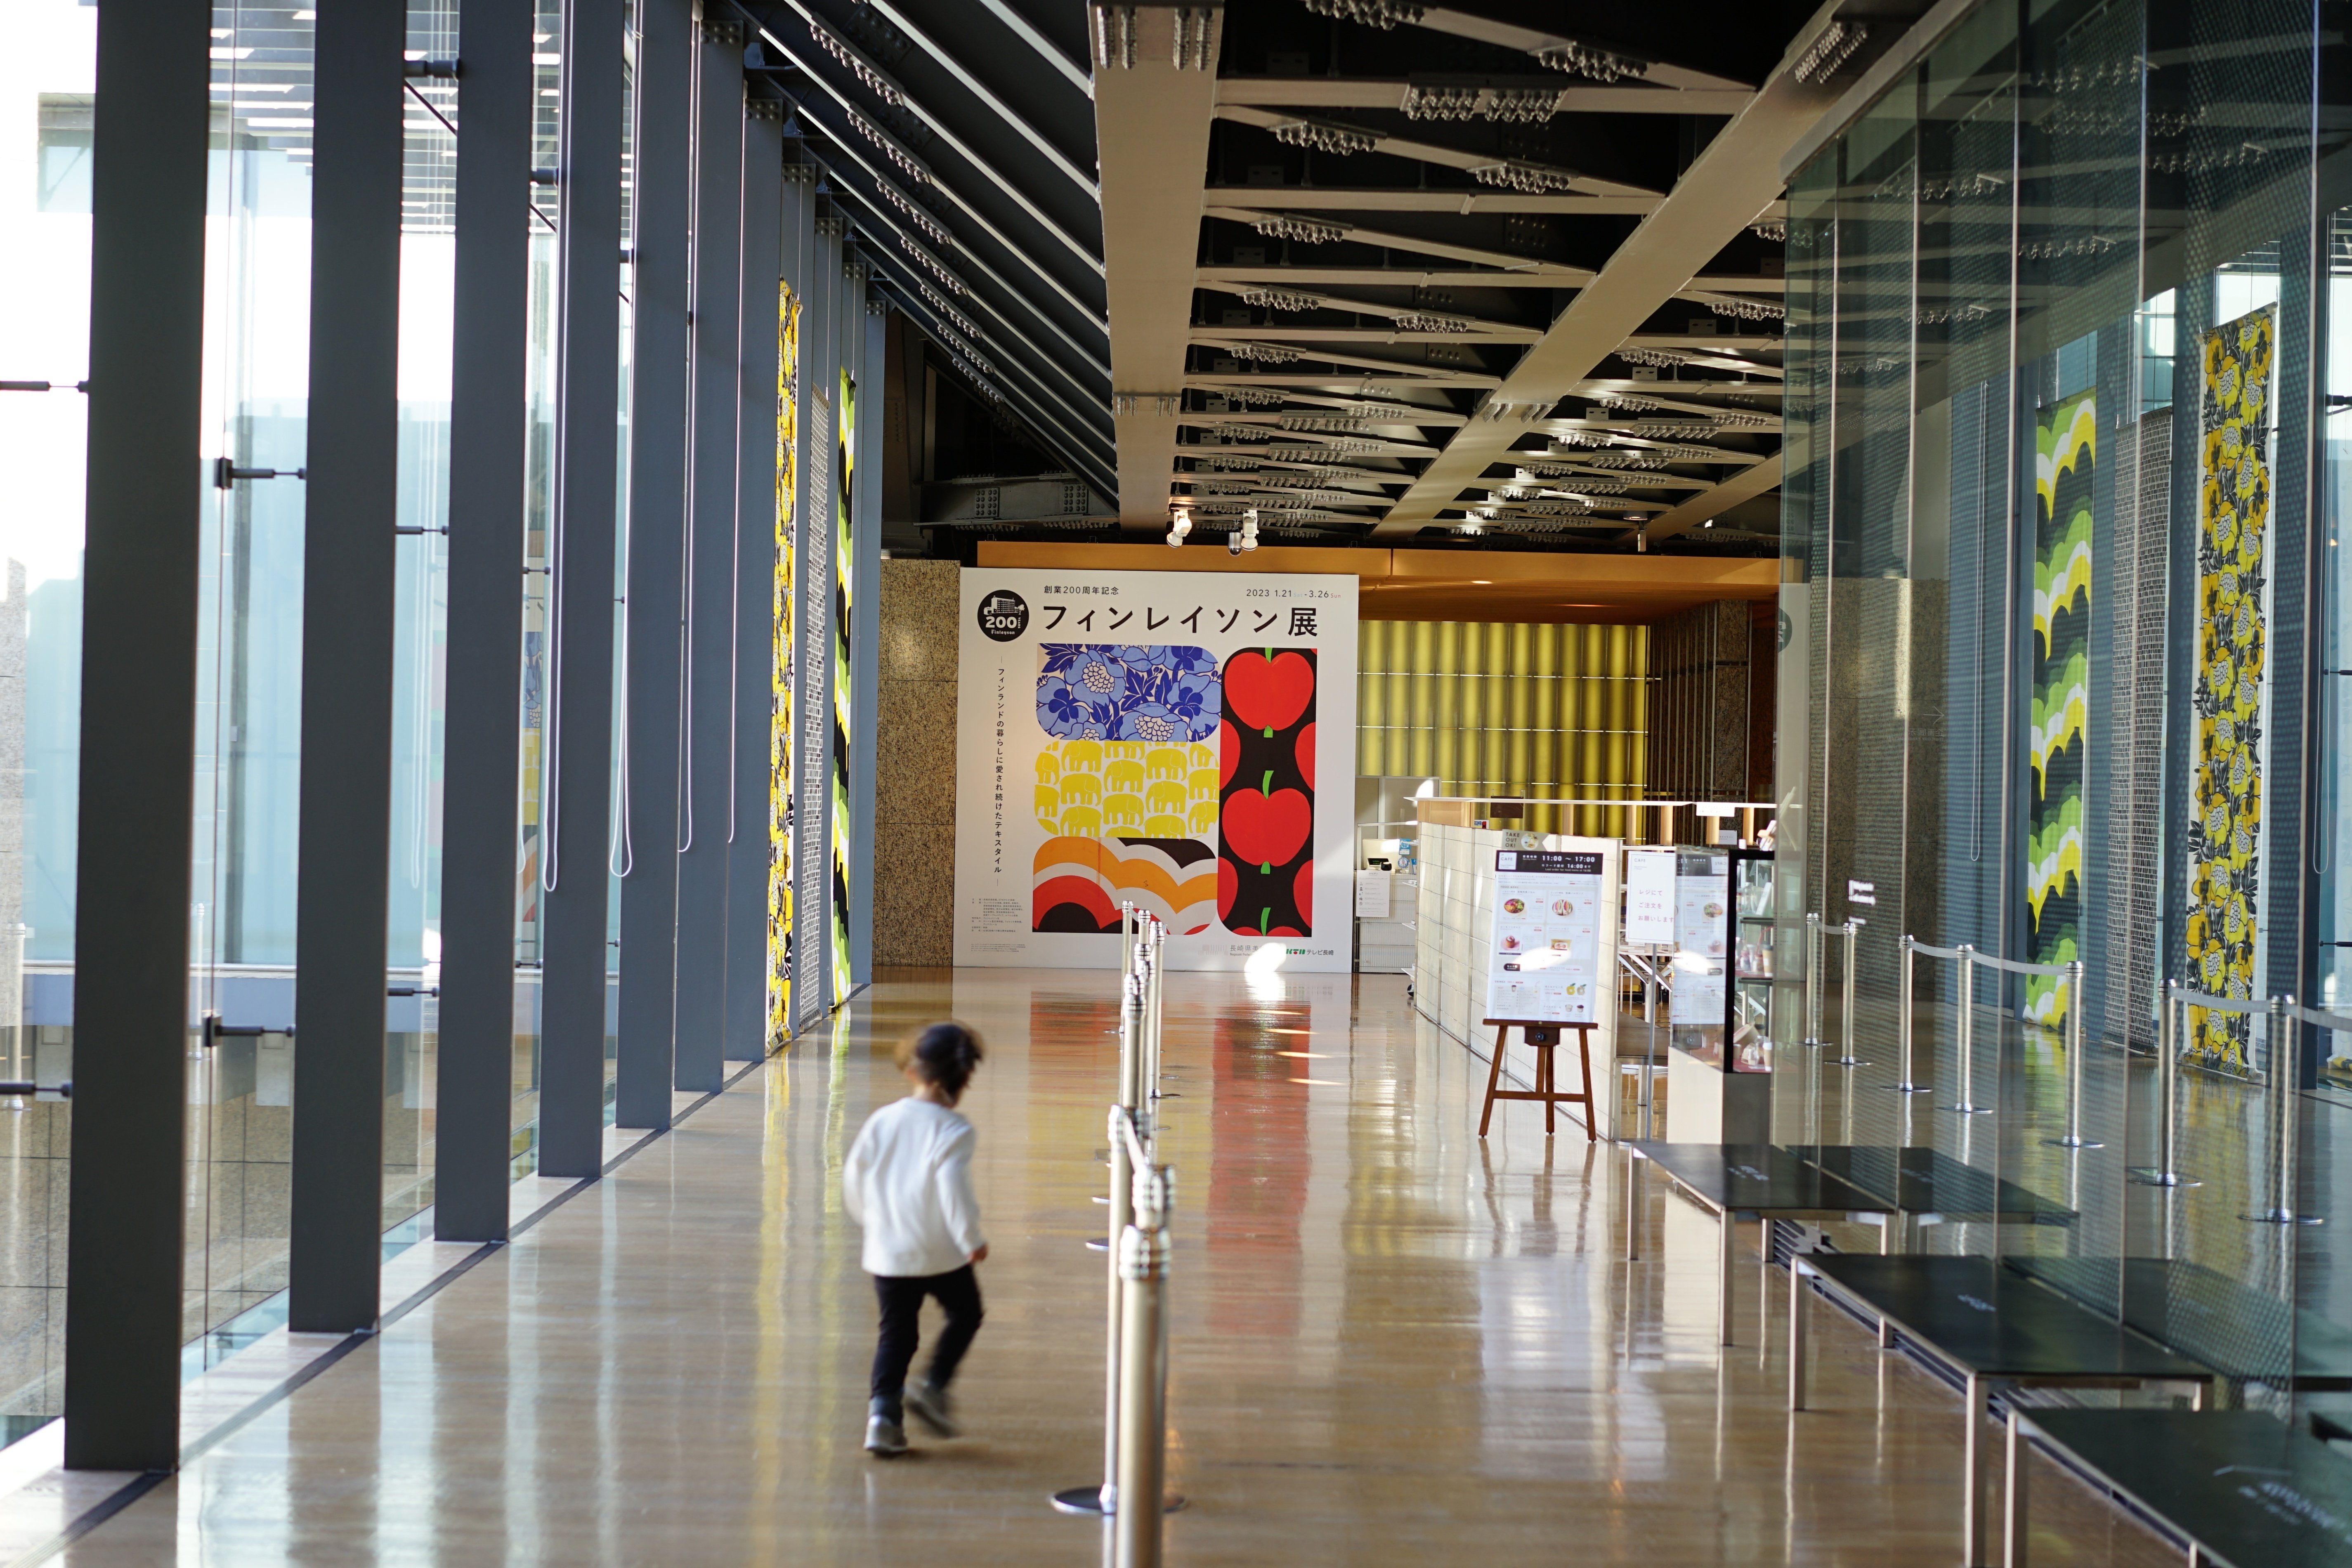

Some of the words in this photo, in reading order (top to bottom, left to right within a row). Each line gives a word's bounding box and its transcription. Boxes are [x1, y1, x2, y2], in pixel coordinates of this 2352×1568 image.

[1044, 586, 1119, 595] 創業200周年記念
[985, 616, 1017, 628] 200
[1044, 605, 1318, 637] フィンレイソン展
[994, 668, 1005, 873] フィンランドの暮らしに愛され続けたテキスタイル
